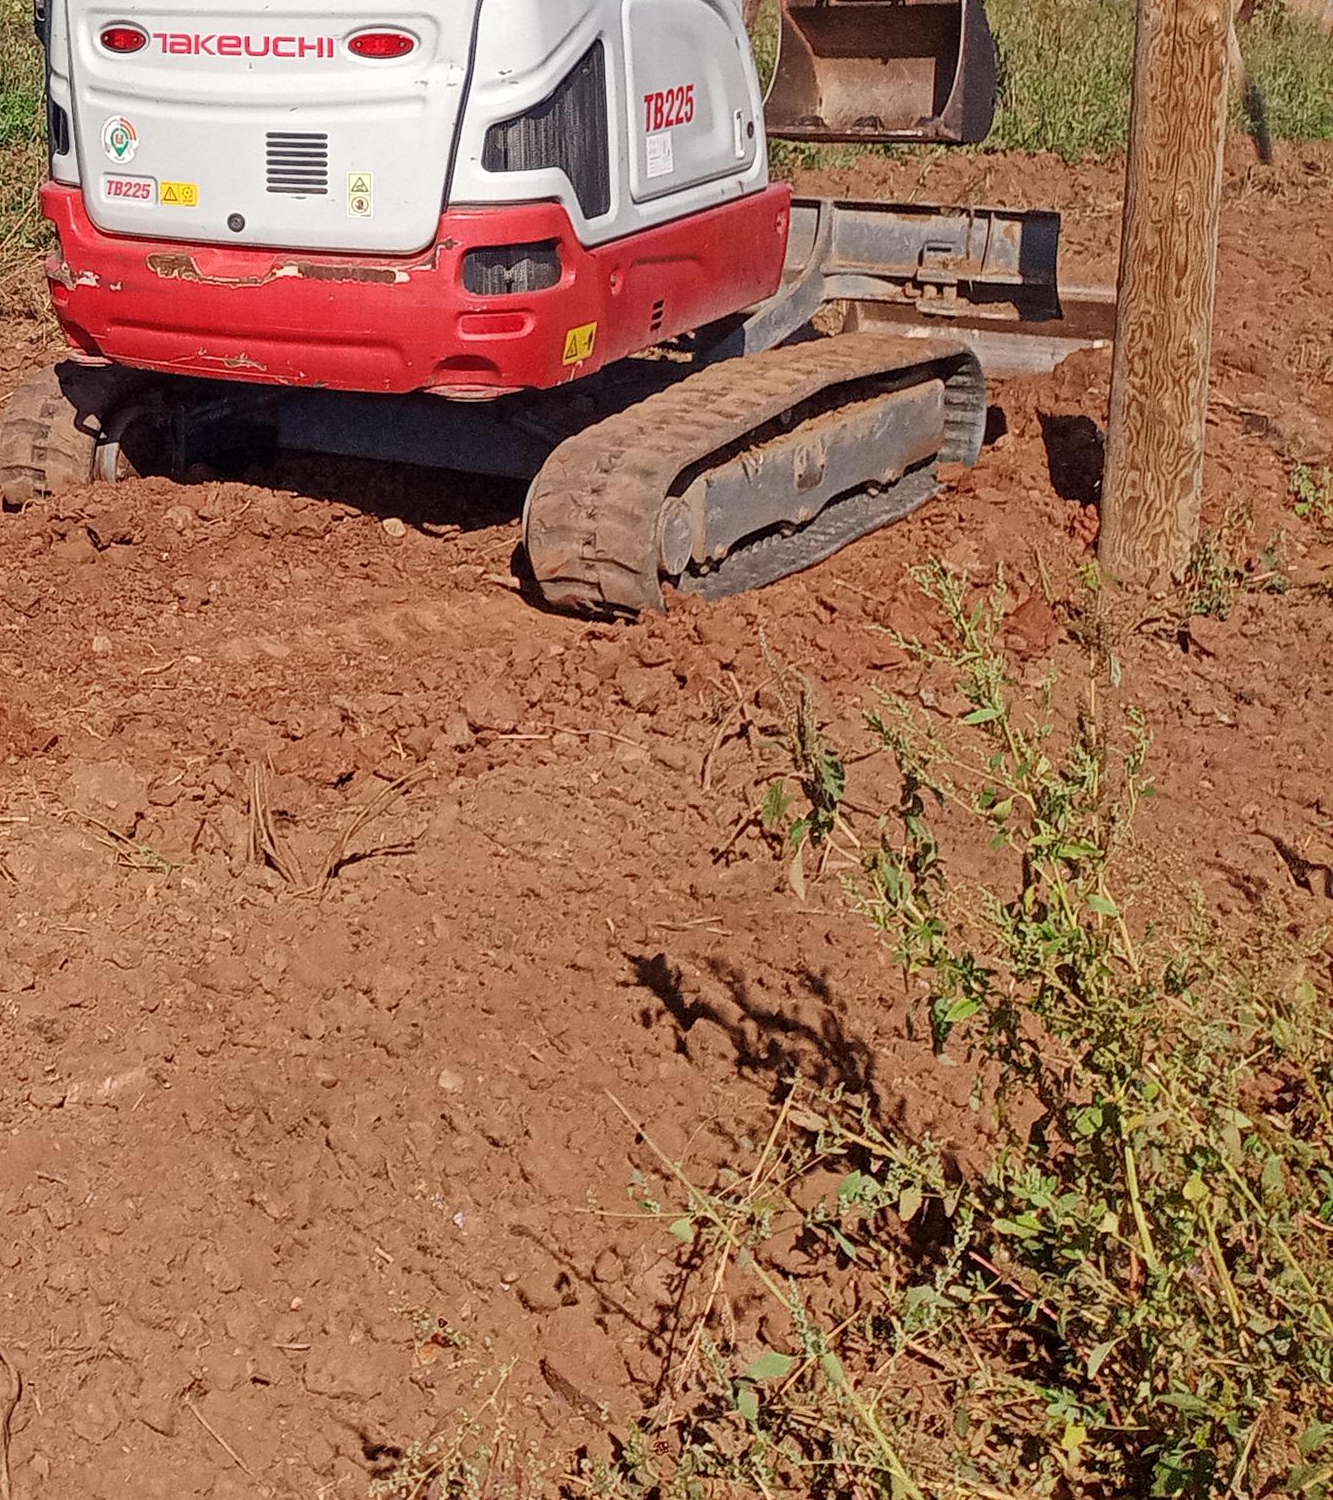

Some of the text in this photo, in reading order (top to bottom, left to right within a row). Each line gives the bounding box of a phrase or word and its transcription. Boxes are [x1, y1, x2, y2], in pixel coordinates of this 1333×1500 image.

[152, 33, 334, 58] TAKEUCHI
[644, 83, 694, 133] TB225
[106, 180, 151, 199] TB225
